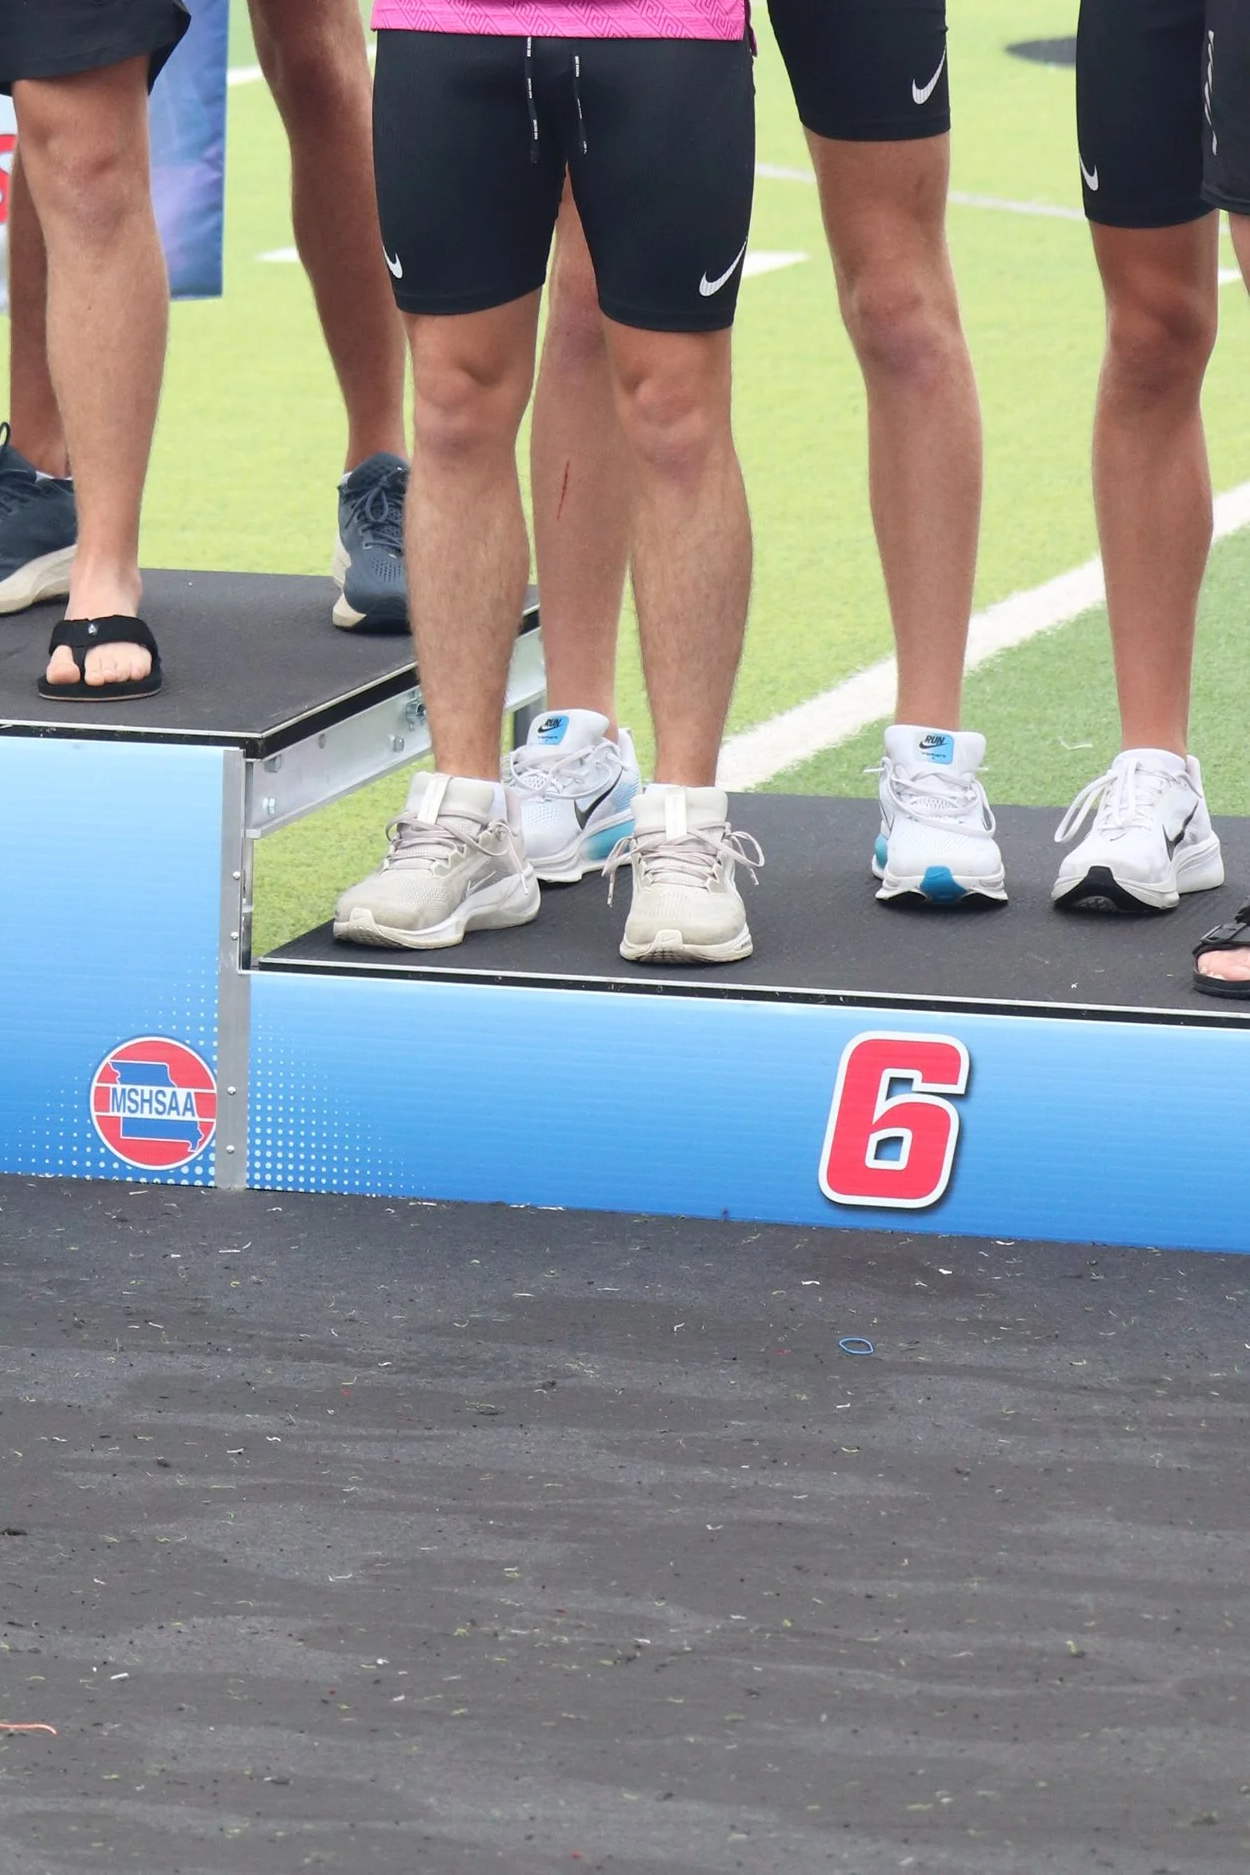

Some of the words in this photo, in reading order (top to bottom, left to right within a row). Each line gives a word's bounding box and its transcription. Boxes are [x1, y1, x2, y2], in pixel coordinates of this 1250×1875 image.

[924, 734, 946, 745] RUN
[110, 1086, 196, 1118] MSHSAA
[817, 1029, 970, 1210] 6
